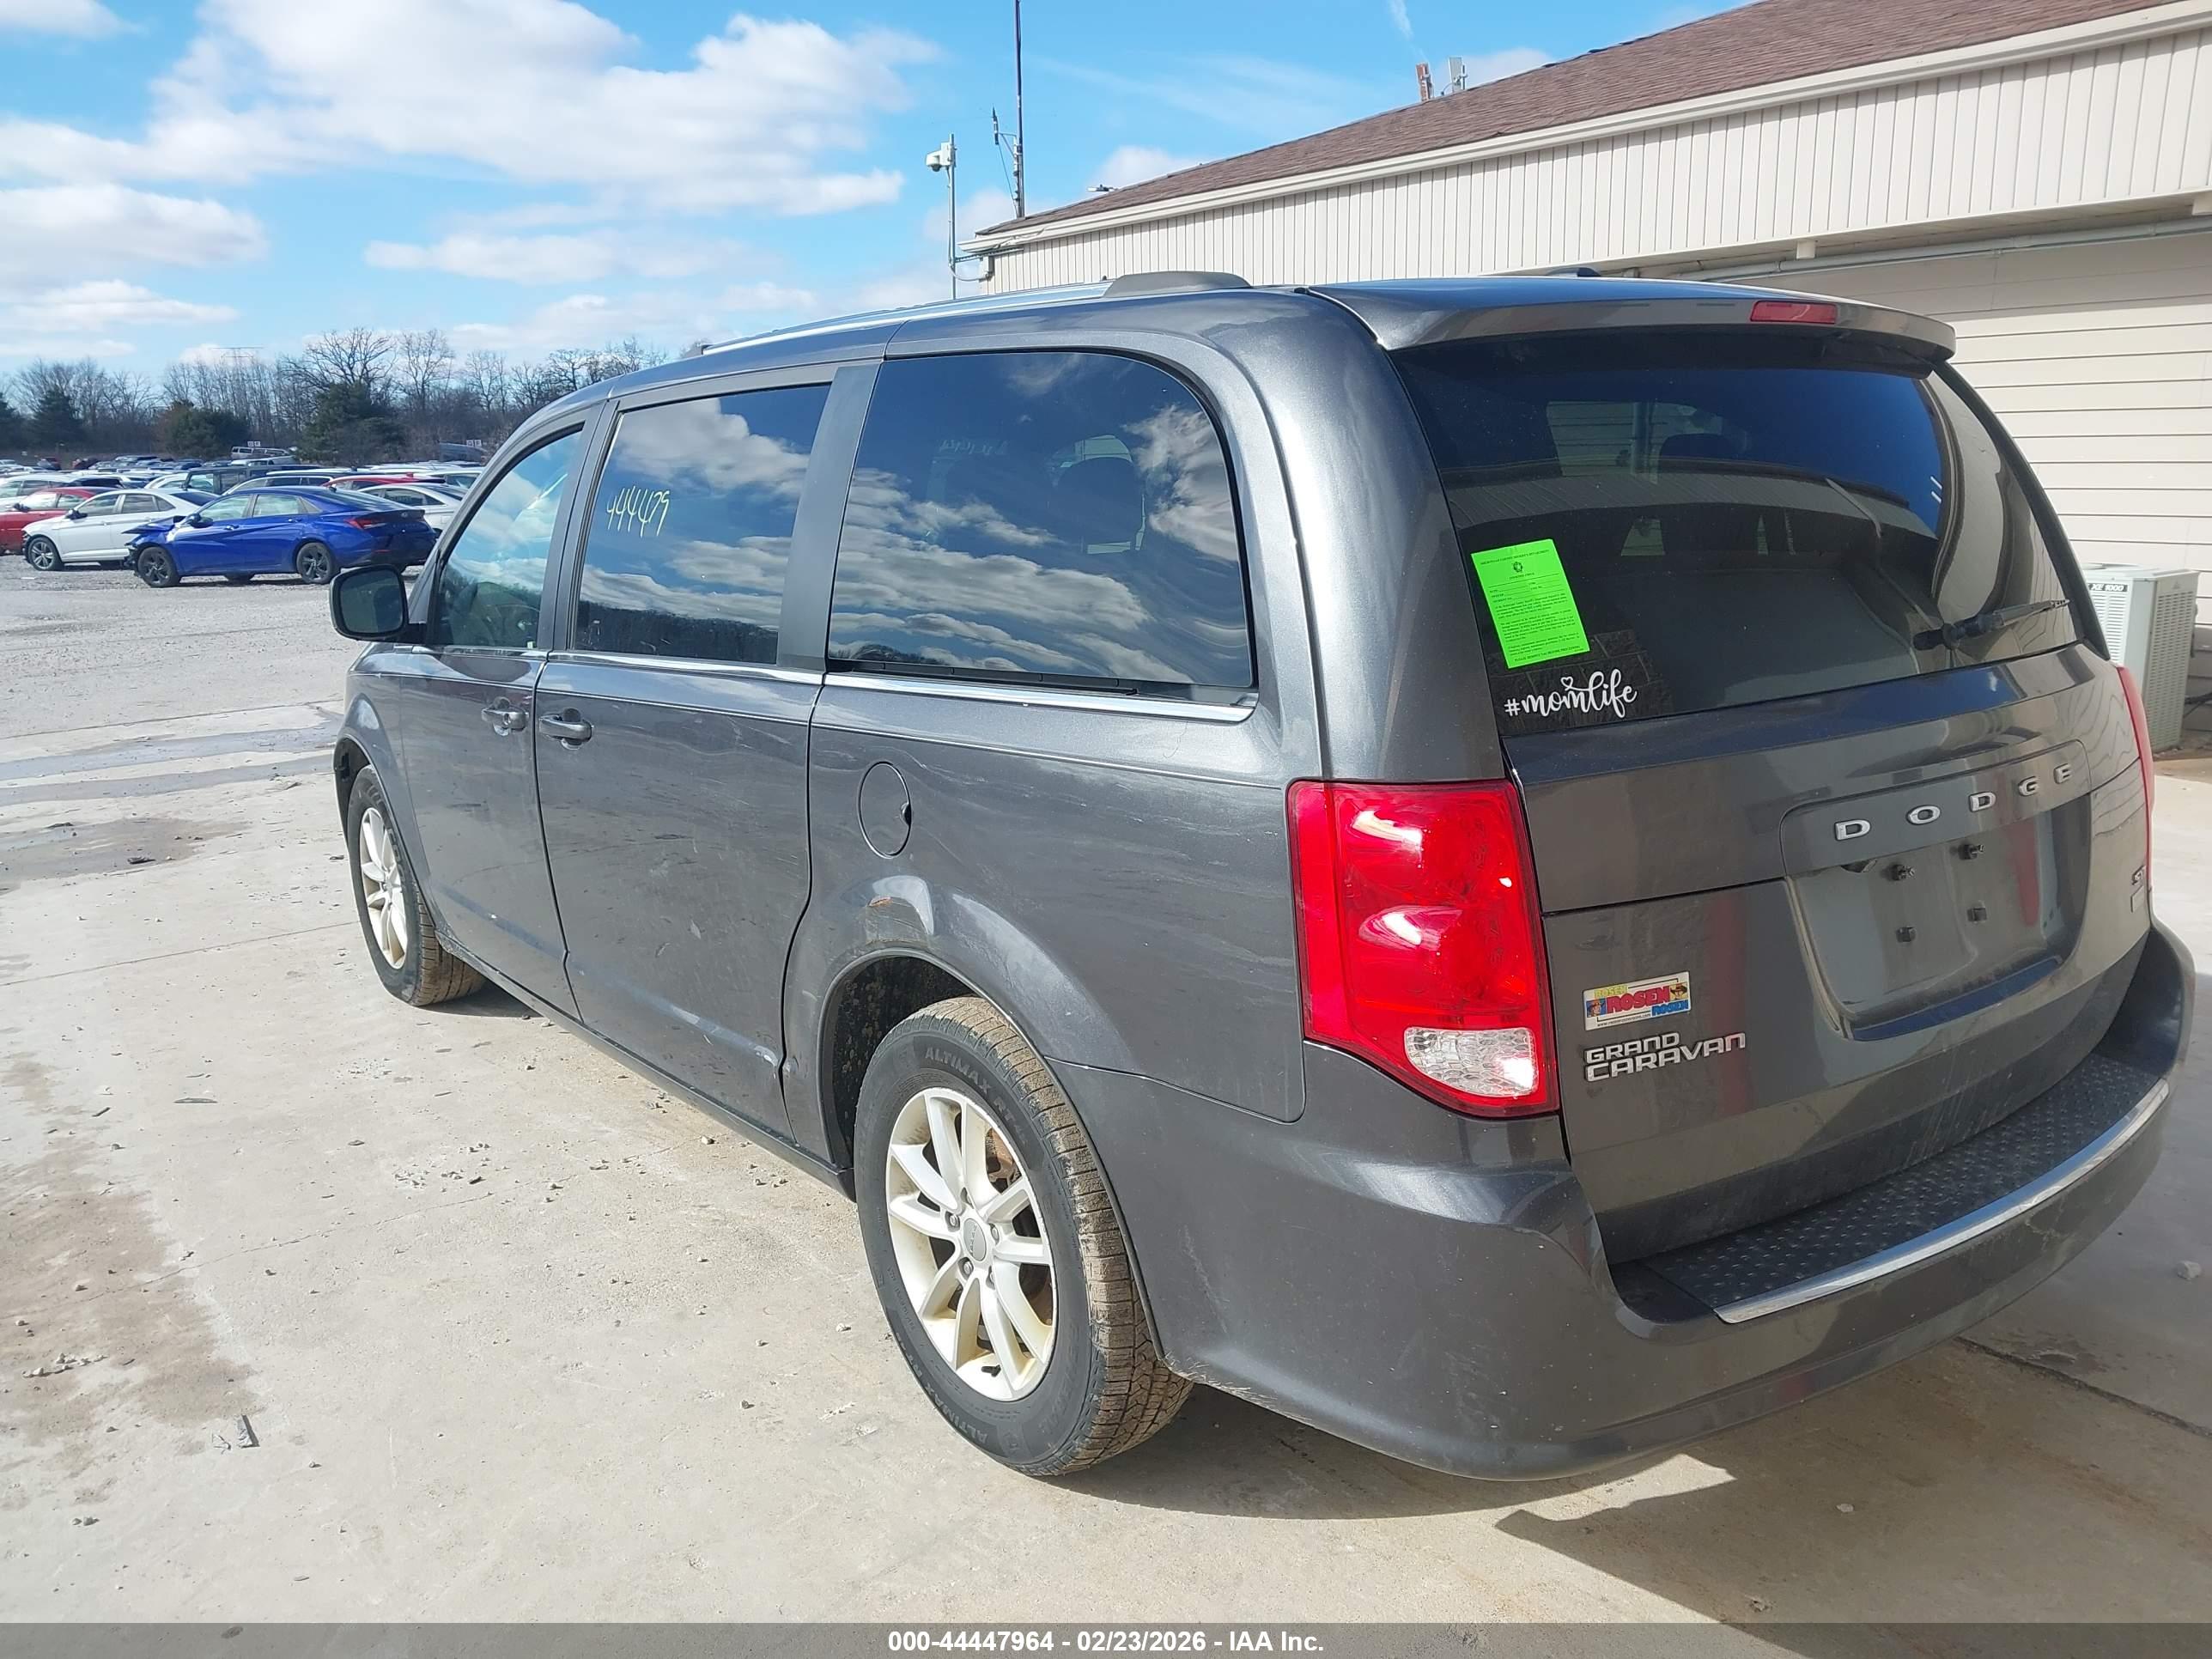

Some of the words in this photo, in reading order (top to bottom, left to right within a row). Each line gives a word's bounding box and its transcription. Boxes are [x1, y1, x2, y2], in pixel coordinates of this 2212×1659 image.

[1504, 668, 1638, 718] #momlife
[1833, 763, 2072, 841] DODGE
[1595, 985, 1628, 998] ROSEN
[1606, 986, 1670, 1014] ROSEN
[1651, 1000, 1689, 1016] ROSEN
[1586, 1032, 1680, 1064] GRAND
[1586, 1032, 1746, 1082] CARAVAN
[925, 1047, 992, 1095] ALTIMAX
